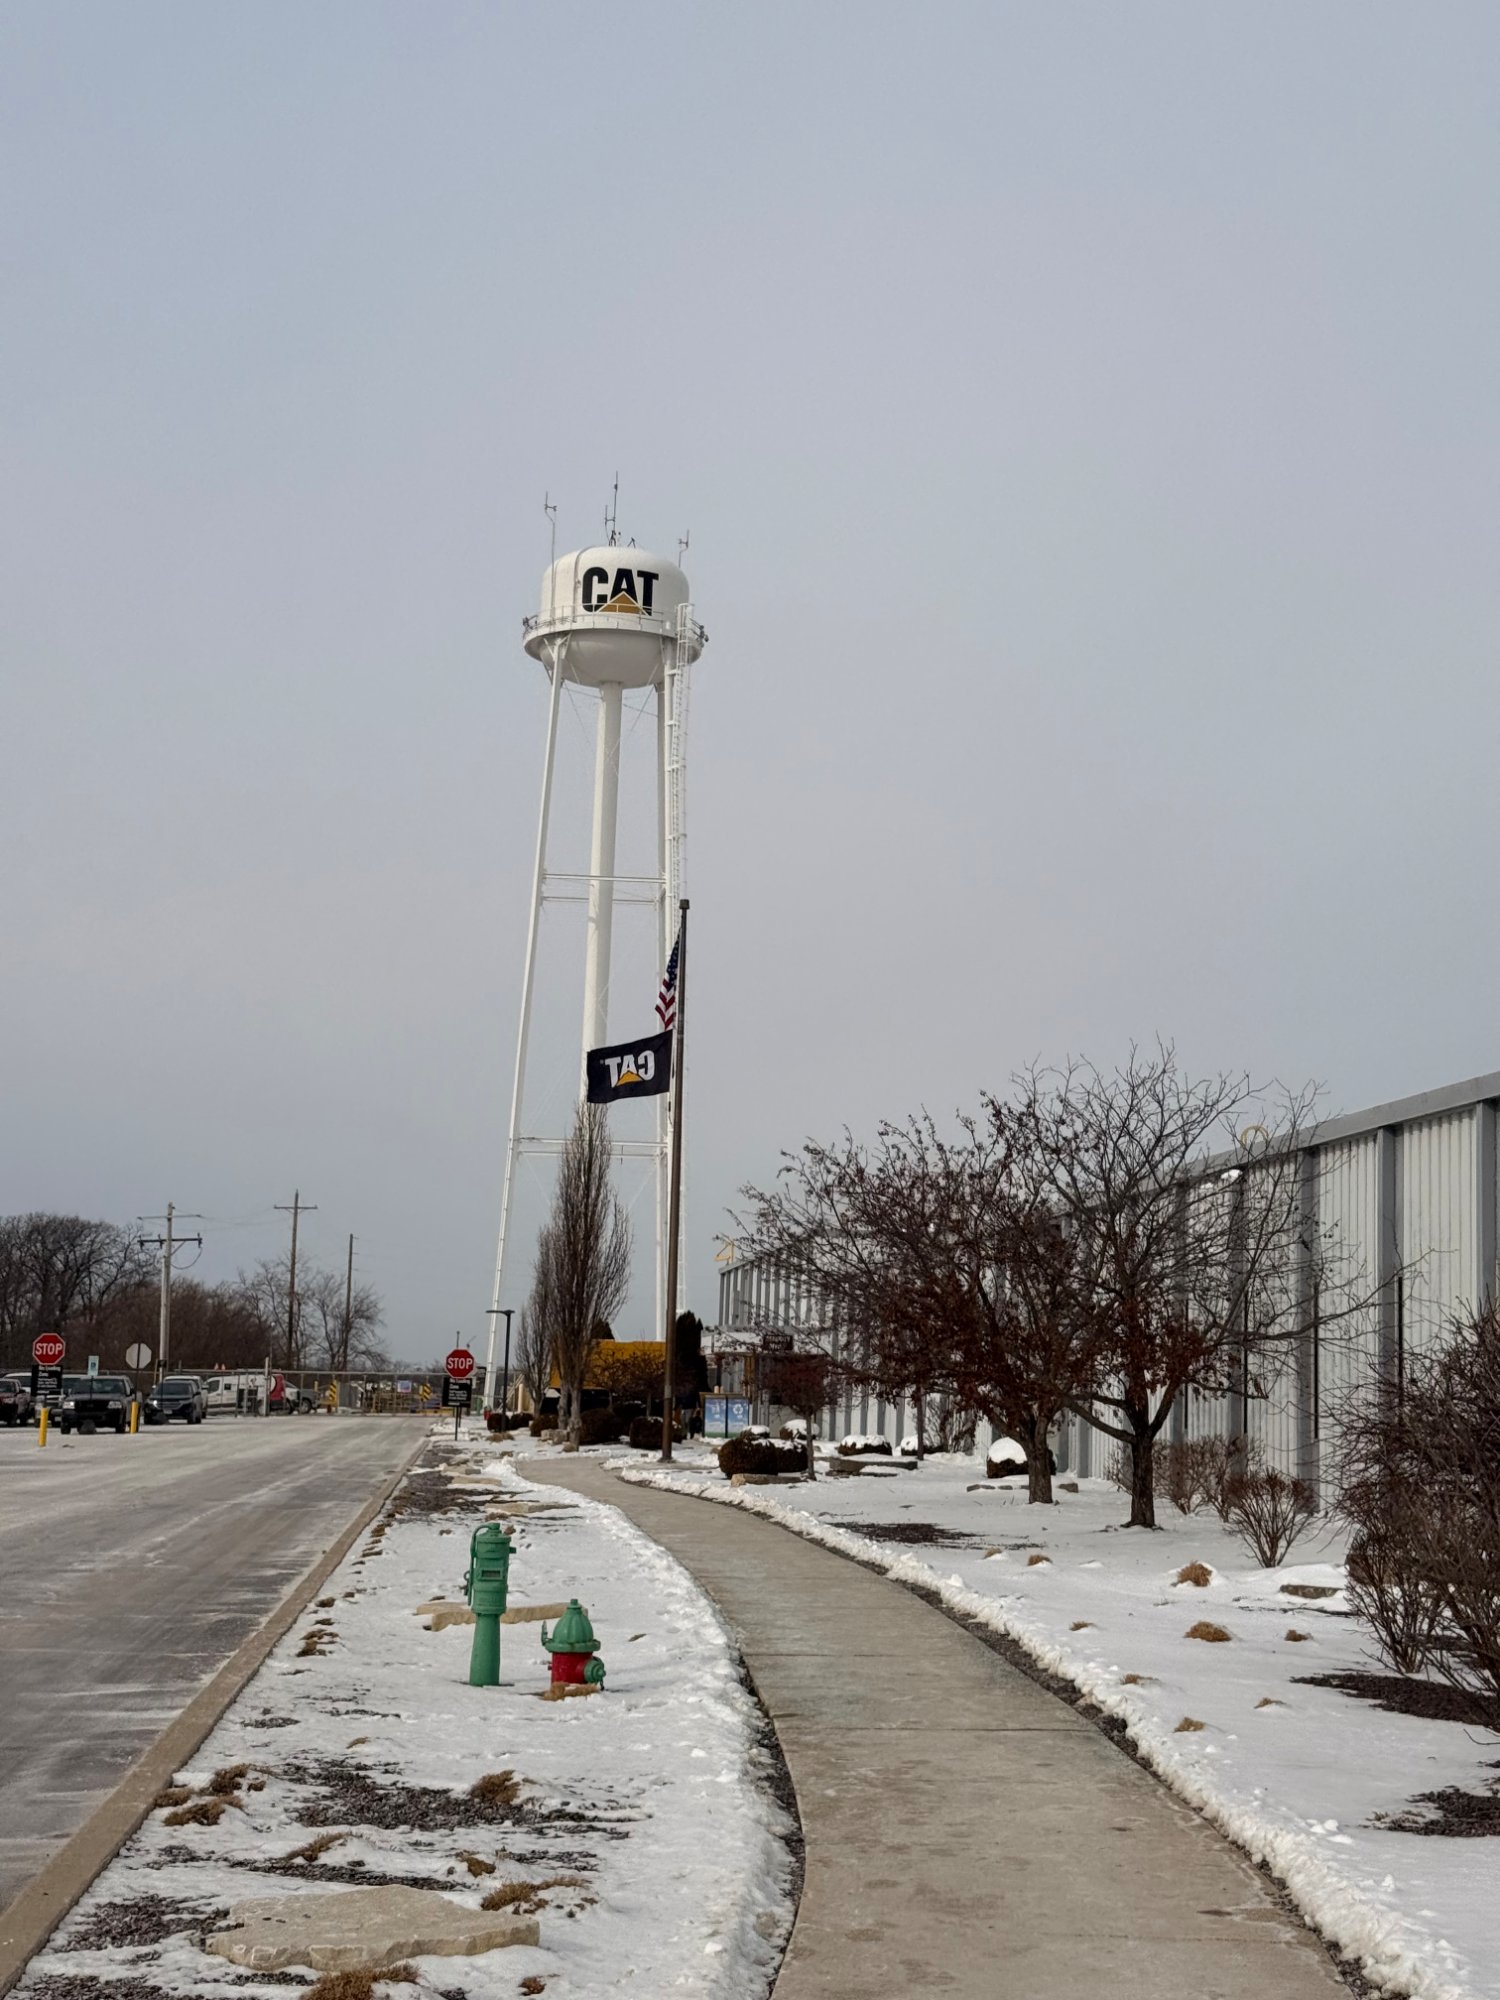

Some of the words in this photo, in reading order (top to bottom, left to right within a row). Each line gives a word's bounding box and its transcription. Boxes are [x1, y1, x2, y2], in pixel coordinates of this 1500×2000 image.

[582, 567, 659, 616] CAT
[35, 1342, 63, 1355] STOP
[447, 1357, 473, 1369] STOP
